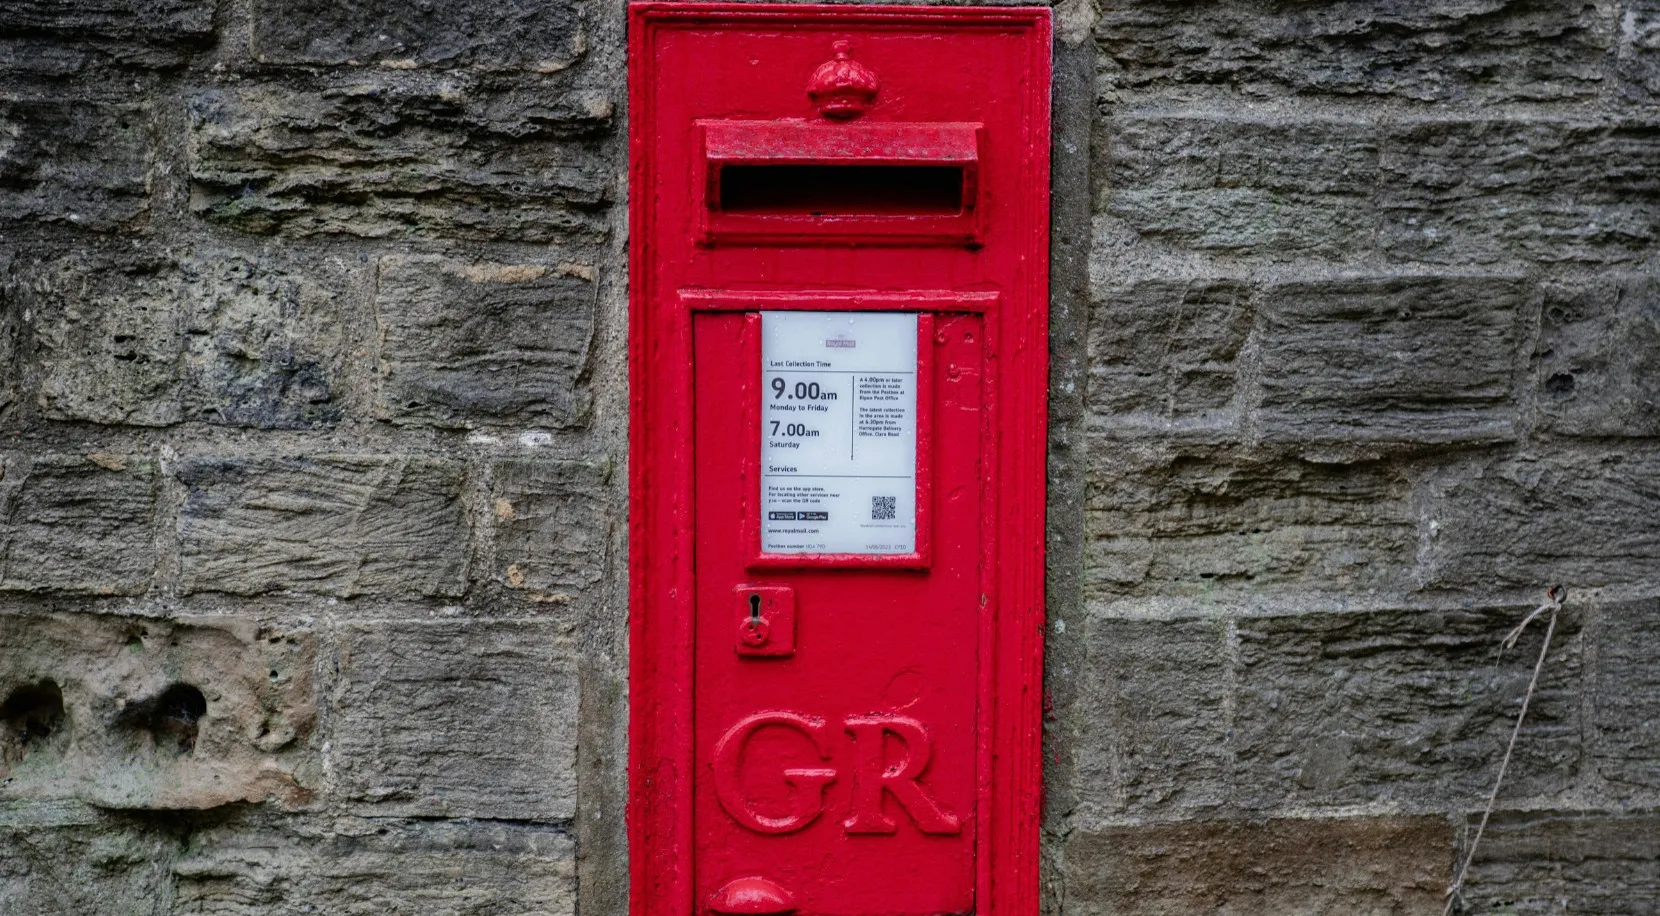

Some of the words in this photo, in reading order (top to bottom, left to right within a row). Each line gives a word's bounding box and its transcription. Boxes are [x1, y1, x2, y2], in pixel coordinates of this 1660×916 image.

[770, 360, 784, 368] Last
[785, 360, 815, 368] Collection
[771, 377, 838, 400] 9.00am
[770, 404, 797, 412] Monday
[807, 404, 829, 412] Friday
[770, 421, 820, 437] 7.00am
[769, 441, 800, 450] Saturday
[769, 465, 798, 473] Services
[712, 709, 962, 837] GR
